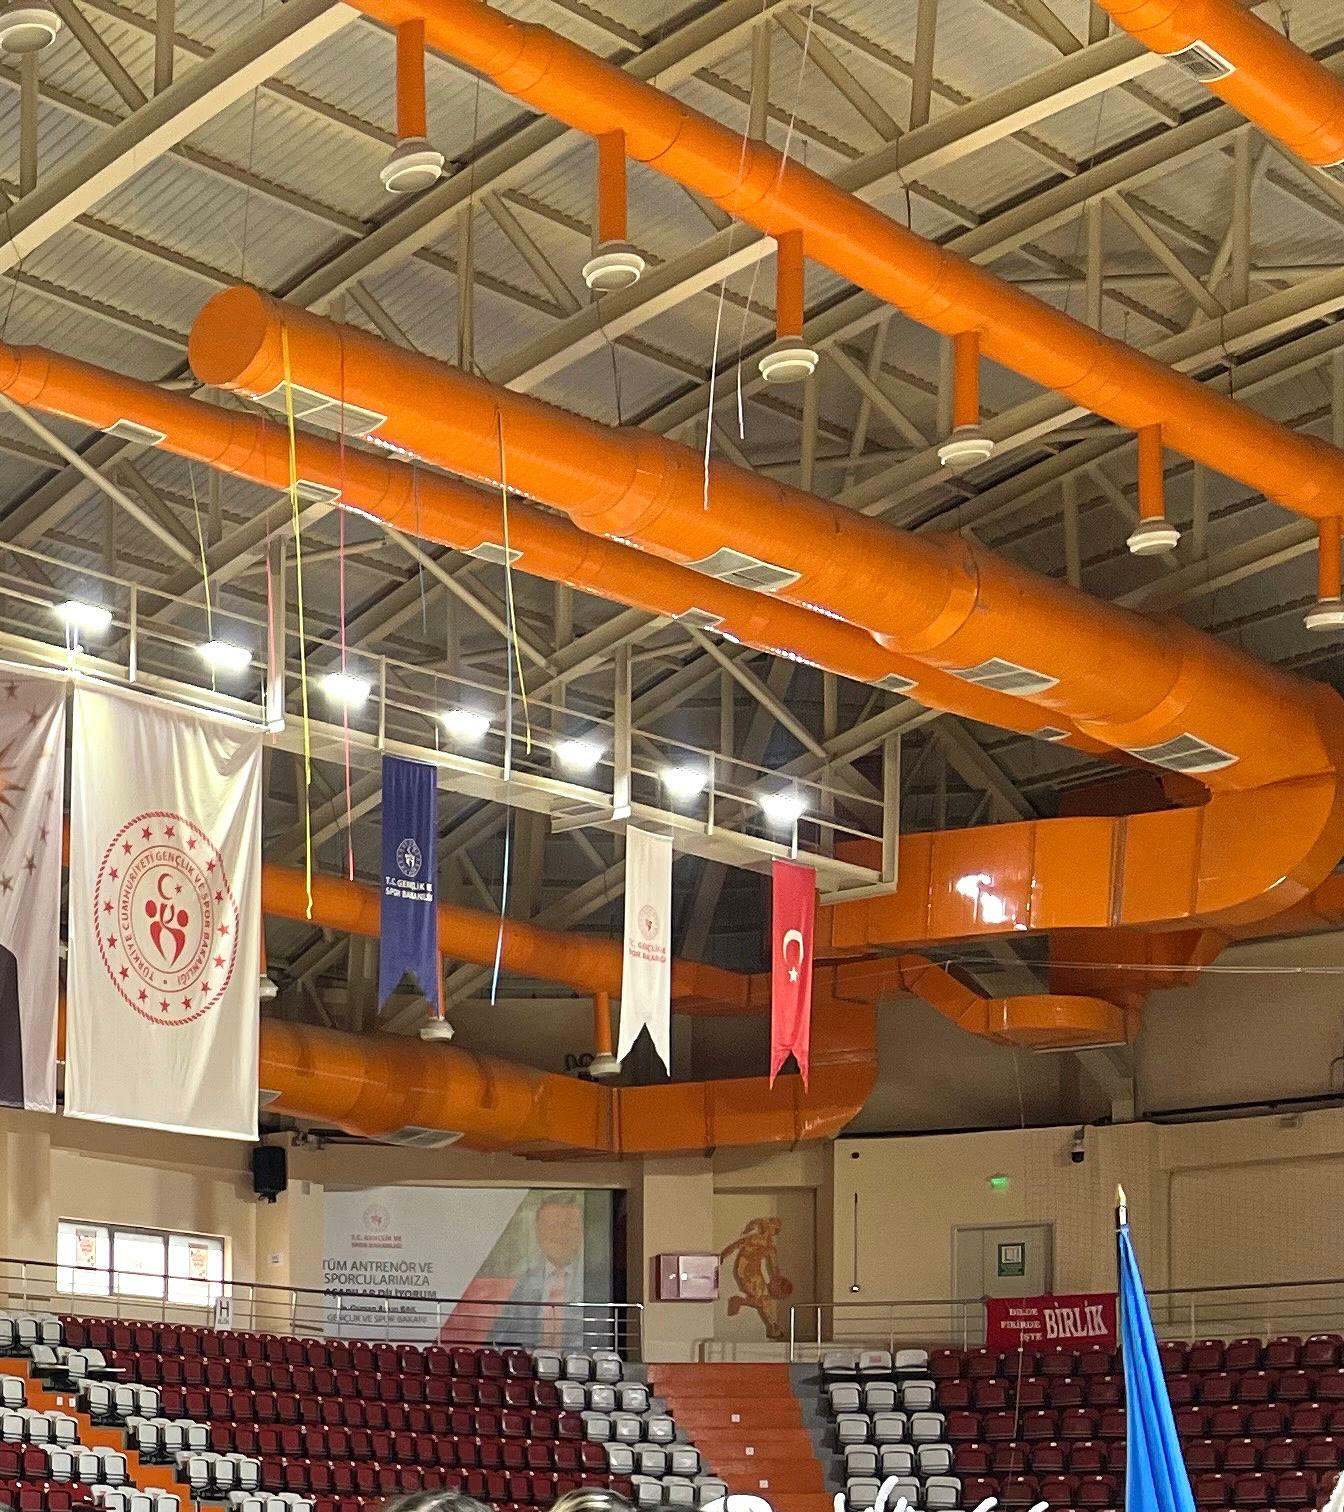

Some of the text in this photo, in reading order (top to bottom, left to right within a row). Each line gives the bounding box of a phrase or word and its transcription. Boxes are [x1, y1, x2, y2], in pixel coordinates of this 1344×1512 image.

[419, 1262, 433, 1274] VE
[219, 1300, 229, 1318] H
[1043, 1300, 1109, 1339] BİRLİK
